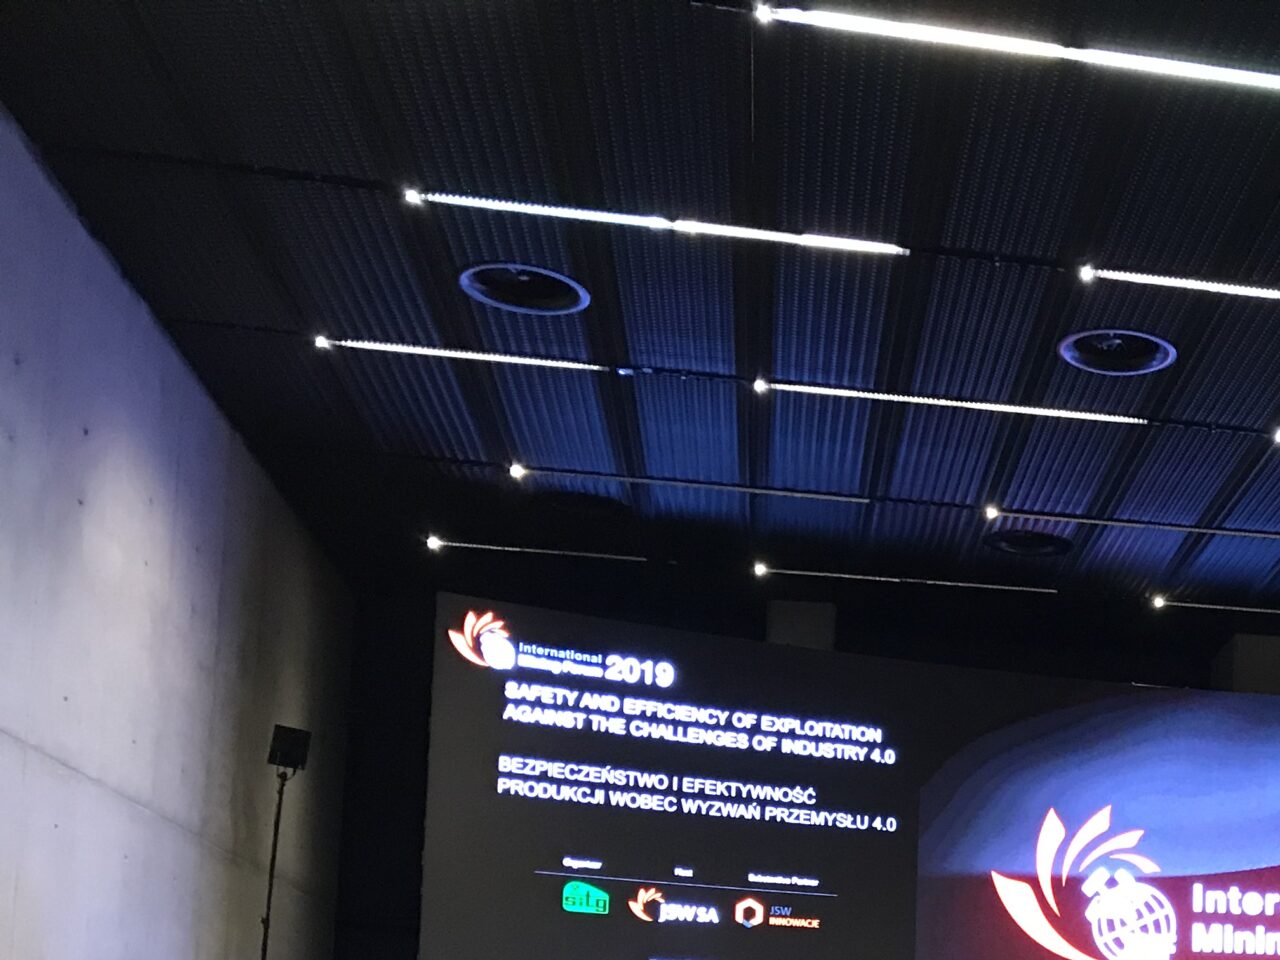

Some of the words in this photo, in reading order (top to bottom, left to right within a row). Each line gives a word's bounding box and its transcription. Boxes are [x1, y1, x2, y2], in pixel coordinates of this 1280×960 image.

[519, 642, 603, 664] International
[604, 654, 675, 688] 2019
[502, 703, 587, 729] AGAINST
[589, 714, 626, 735] THE
[629, 720, 749, 749] CHALLENGES
[752, 735, 777, 752] OF
[781, 738, 868, 761] INDUSTRY
[870, 748, 896, 764] 4.0
[504, 681, 579, 707] SAFETY
[579, 692, 620, 713] AND
[623, 698, 729, 726] EFFICIENCY
[732, 712, 757, 729] OF
[761, 716, 882, 743] EXPLOITATION
[497, 777, 604, 805] PRODUKCJI
[609, 790, 677, 812] WOBEC
[681, 798, 760, 820] WYZWAŃ
[765, 806, 868, 829] PRZEMYSŁU
[872, 816, 897, 832] 4.0
[498, 755, 668, 790] BEZPIECZEŃSTWO
[672, 776, 678, 791] I
[682, 777, 816, 805] EFEKTYWNOŚĆ
[769, 905, 792, 916] JSW
[769, 917, 821, 928] INNOWACJE
